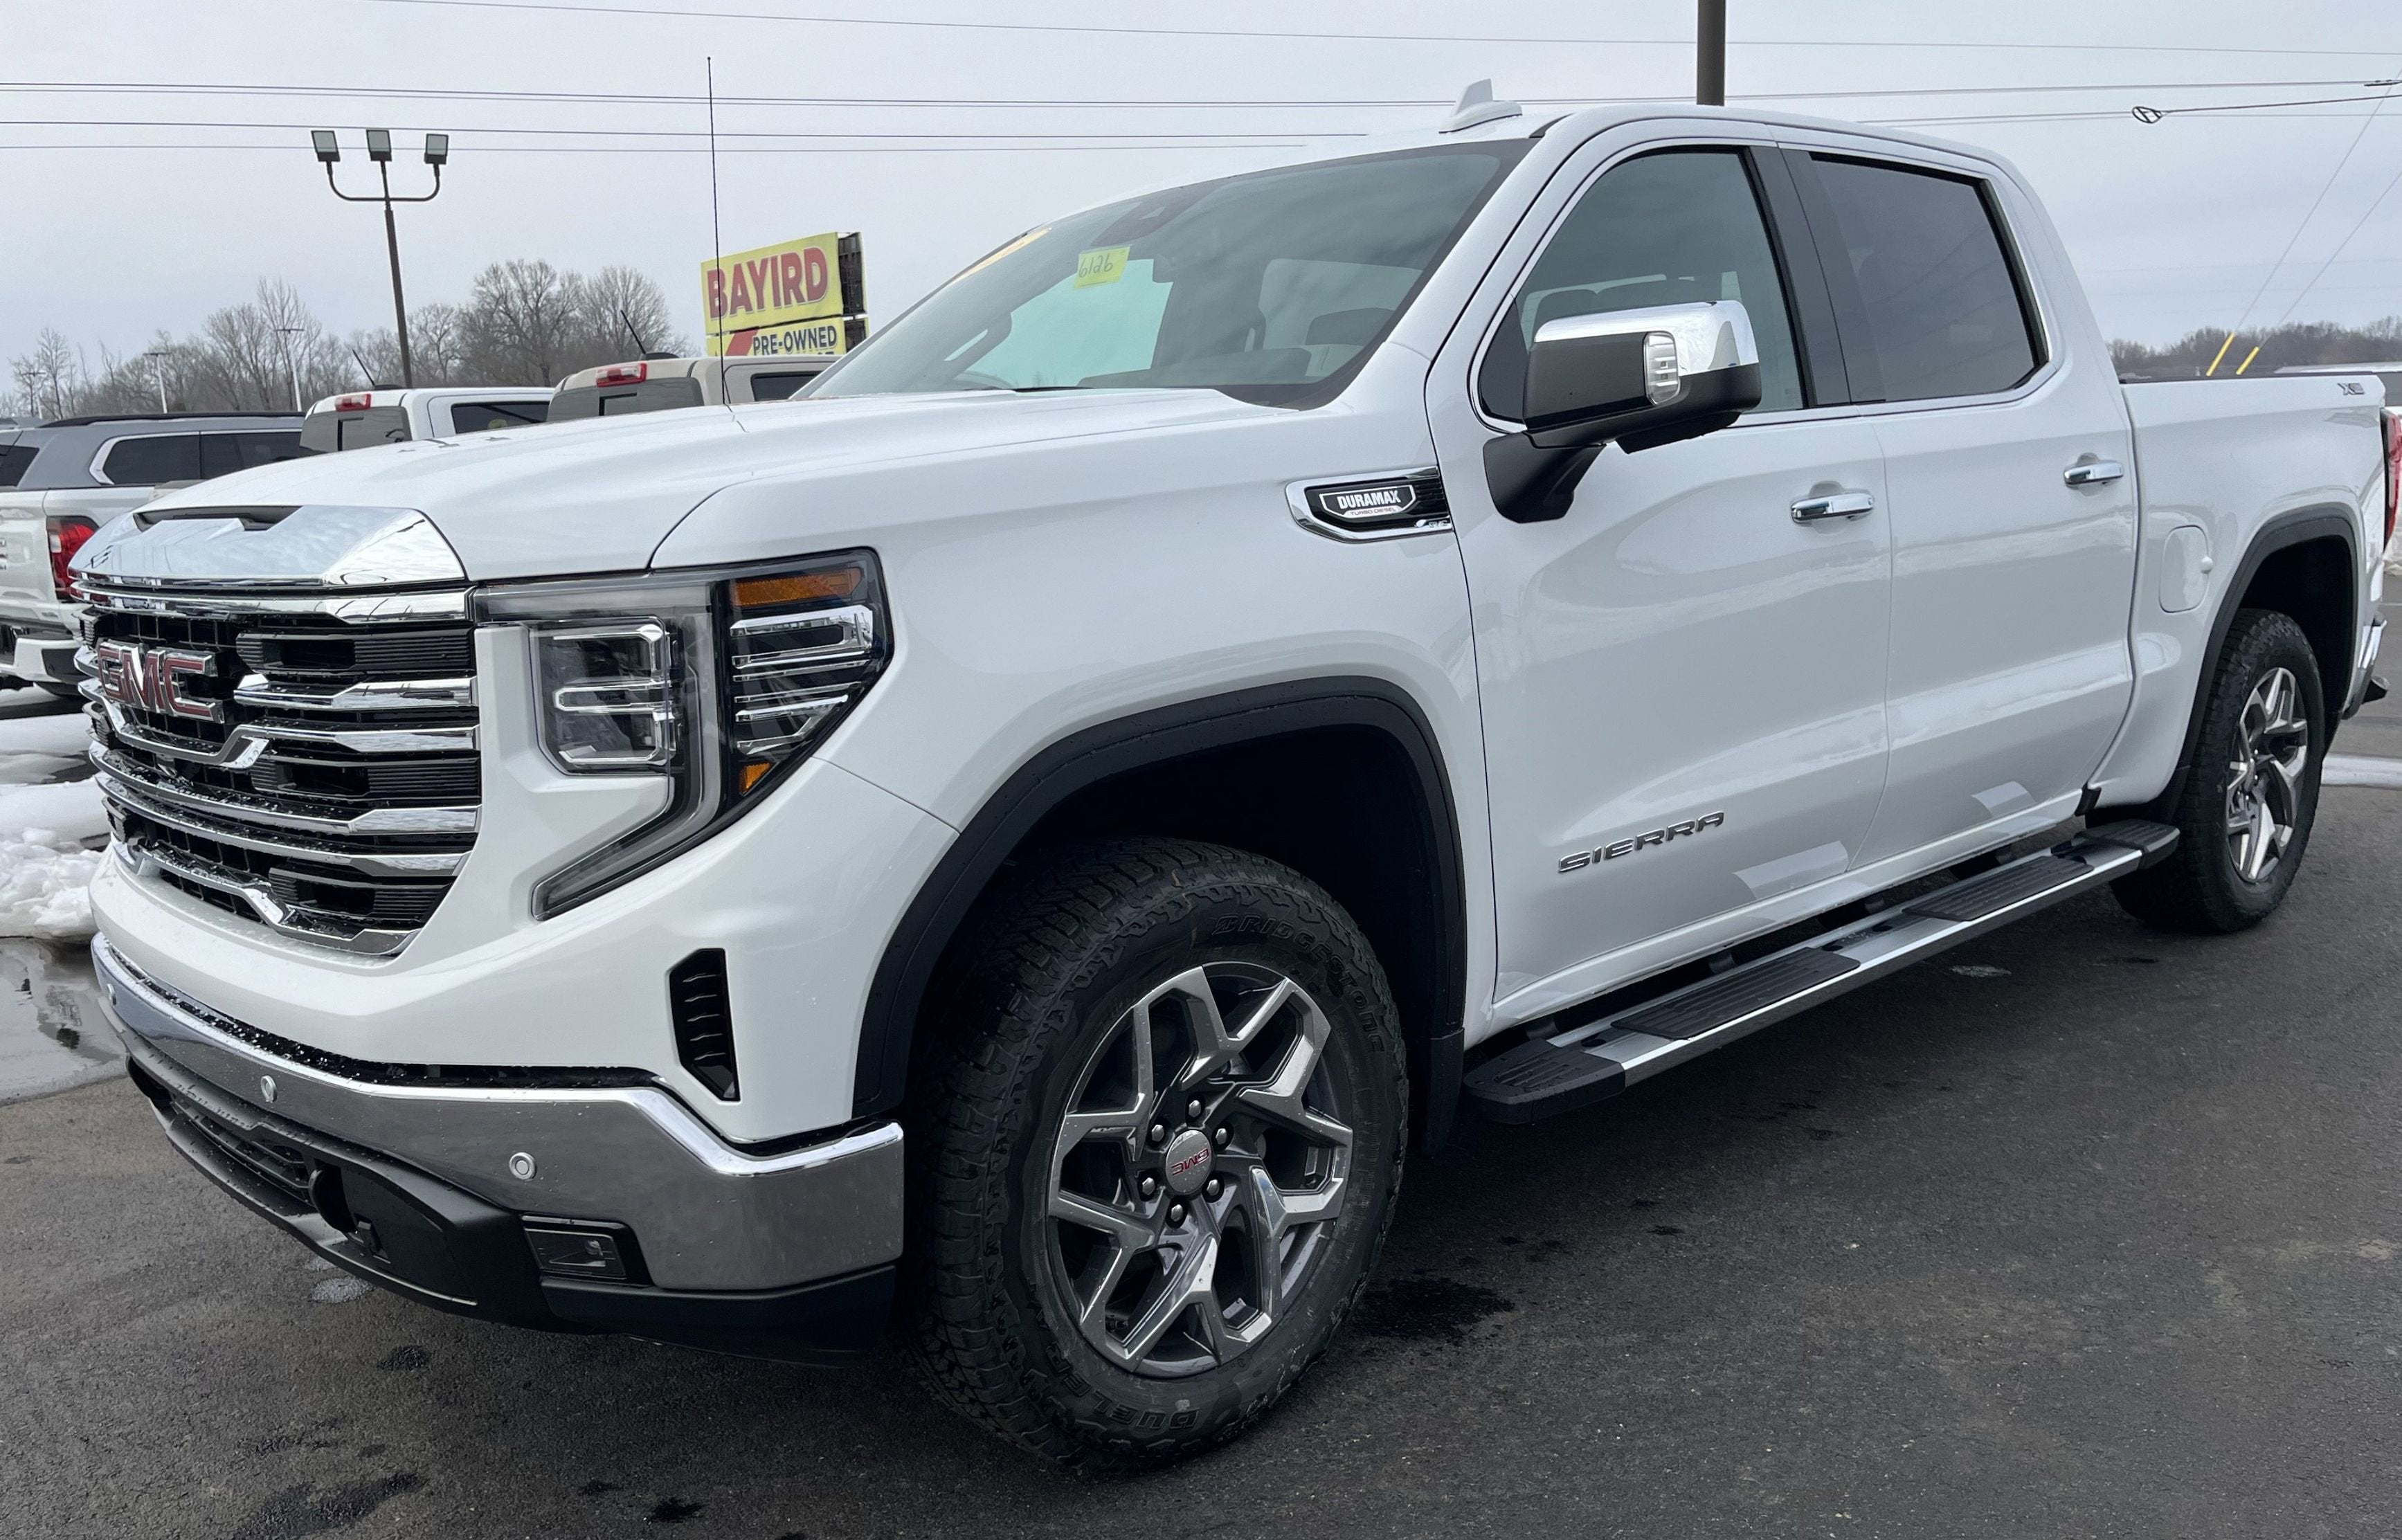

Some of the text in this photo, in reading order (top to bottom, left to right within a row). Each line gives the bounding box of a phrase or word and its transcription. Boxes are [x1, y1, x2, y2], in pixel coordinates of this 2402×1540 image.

[707, 247, 828, 320] BAYIRD
[1078, 253, 1113, 278] 6126
[752, 326, 838, 355] PRE-OWNED
[1337, 490, 1401, 509] DURAMAX
[98, 641, 225, 724] GMC
[1557, 810, 1725, 874] SIERRA
[1211, 912, 1386, 1053] BRIDGESTONE
[1171, 1148, 1209, 1176] GMC
[1045, 1340, 1201, 1429] DUELER
